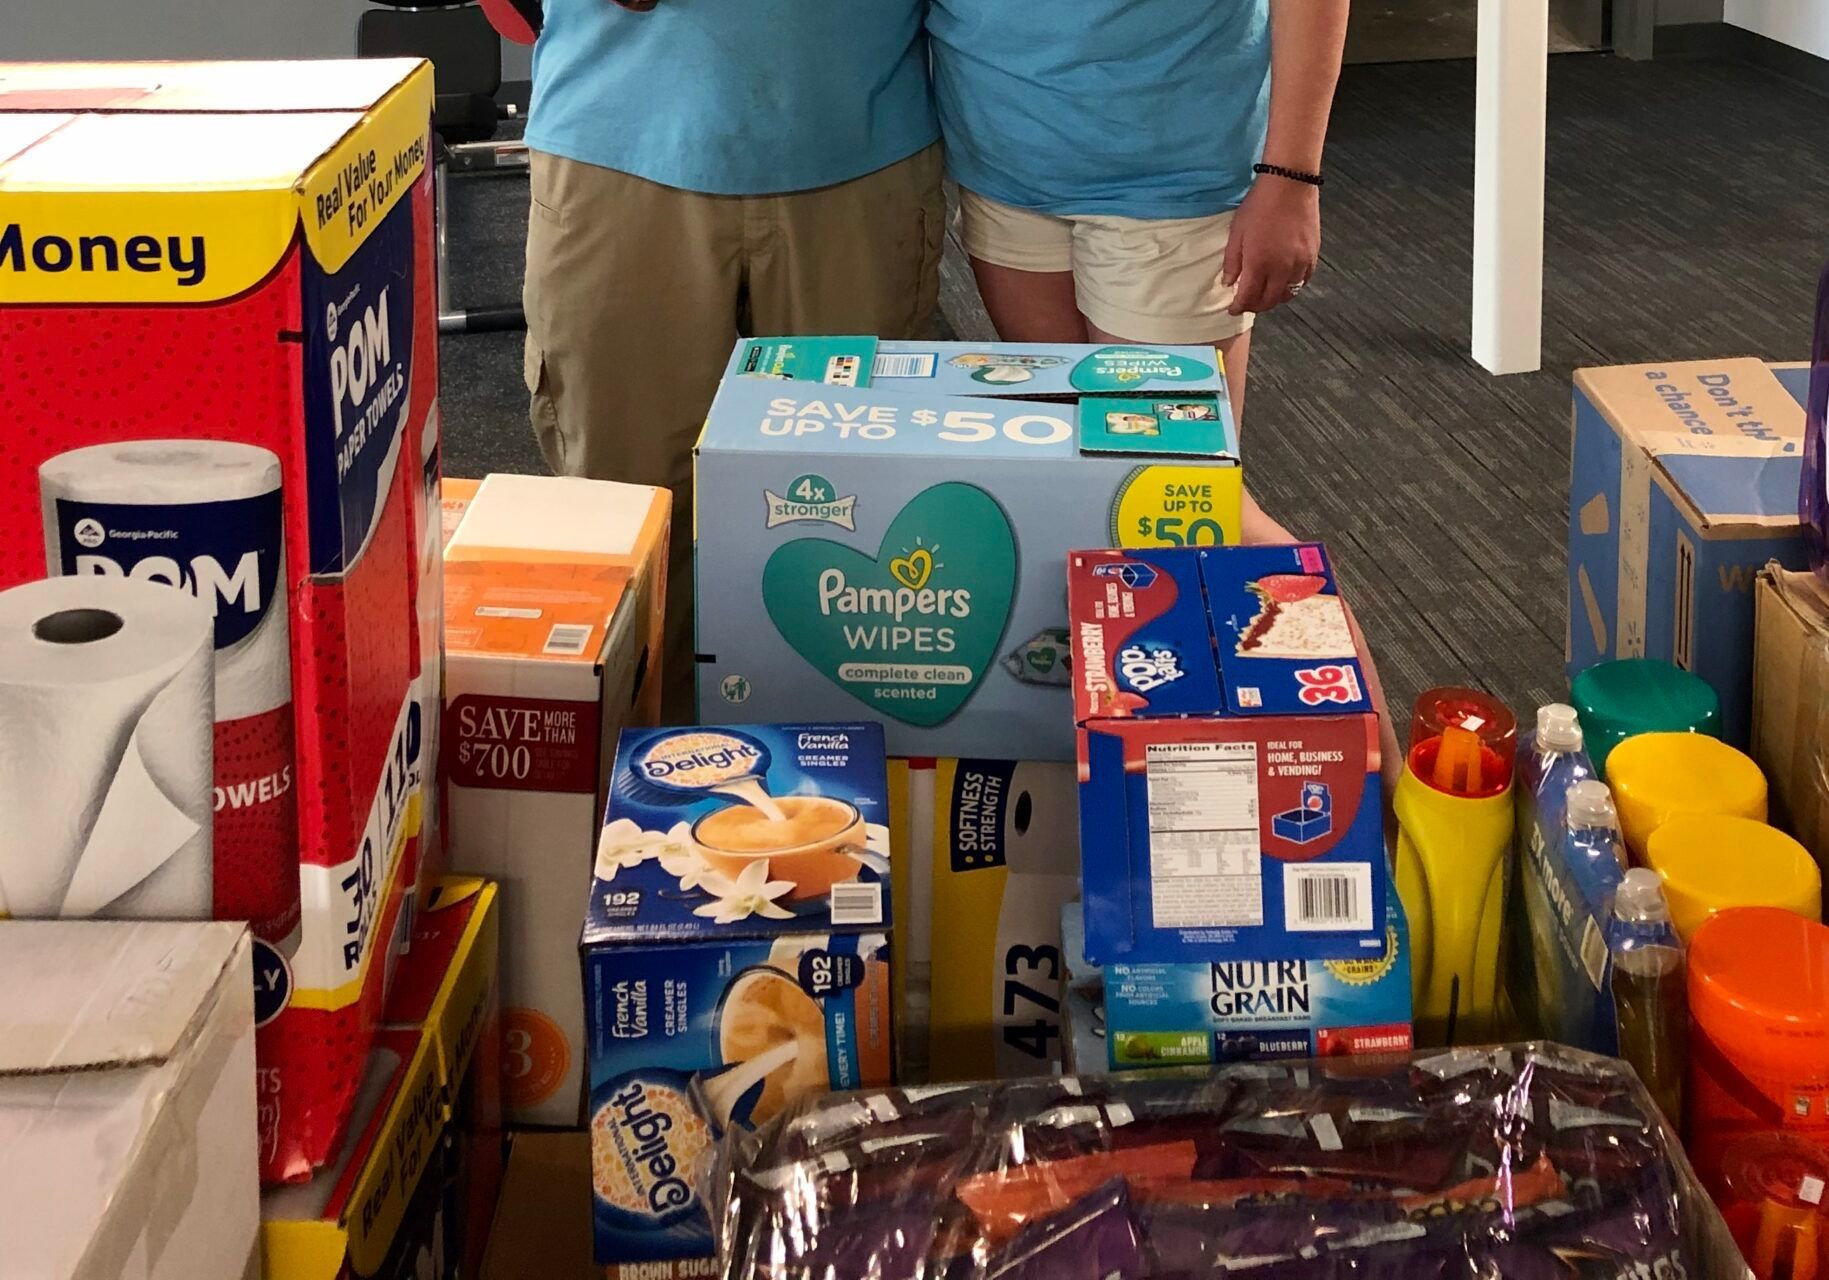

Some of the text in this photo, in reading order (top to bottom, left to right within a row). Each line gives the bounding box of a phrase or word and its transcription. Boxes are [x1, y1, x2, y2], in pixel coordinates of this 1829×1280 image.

[316, 148, 377, 231] Real Value
[347, 196, 368, 238] For
[393, 133, 425, 184] Money
[330, 287, 391, 440] POM
[1645, 371, 1713, 435] a chance
[1696, 374, 1754, 418] Don't
[337, 361, 403, 485] PAPER TOWELS
[760, 418, 897, 440] UP TO
[767, 397, 1073, 444] SAVE $50
[795, 478, 825, 501] 4x
[1163, 499, 1213, 513] UP TO
[1164, 483, 1212, 498] SAVE
[774, 503, 849, 519] stronger
[818, 568, 971, 622] Pampers
[843, 625, 956, 652] WIPES
[845, 666, 966, 684] complete clean
[1298, 666, 1350, 704] 36
[874, 685, 937, 700] scented
[459, 705, 541, 741] SAVE
[544, 710, 577, 728] MORE
[544, 726, 576, 744] THAN
[798, 732, 849, 743] French
[798, 741, 849, 750] Vanilla
[1147, 743, 1255, 753] Nutrition Facts
[1266, 740, 1303, 750] IDEAL FOR
[459, 740, 531, 779] $700
[647, 744, 759, 777] Delight
[1267, 751, 1298, 765] HOME,
[1299, 750, 1344, 763] BUSINESS
[1268, 764, 1322, 777] & VENDING!
[959, 771, 984, 851] SOFTNESS
[980, 775, 1003, 851] STRENGTH
[603, 891, 640, 906] 192
[811, 955, 832, 994] 192
[1121, 984, 1136, 993] NO
[1211, 959, 1308, 993] NUTRI
[612, 980, 630, 1039] French
[631, 979, 648, 1039] Vanilla
[664, 979, 675, 1036] CREAMER
[676, 981, 688, 1033] SINGLES
[1003, 944, 1060, 1059] 473
[1210, 983, 1310, 1017] GRAIN
[834, 1012, 846, 1046] TIME!
[1353, 1035, 1410, 1049] STRAWBERRY
[1259, 1040, 1308, 1053] BLUEBERRY
[362, 1070, 434, 1241] Real Value
[611, 1083, 691, 1213] Delight
[401, 1133, 423, 1198] For
[678, 1259, 720, 1279] SUGA
